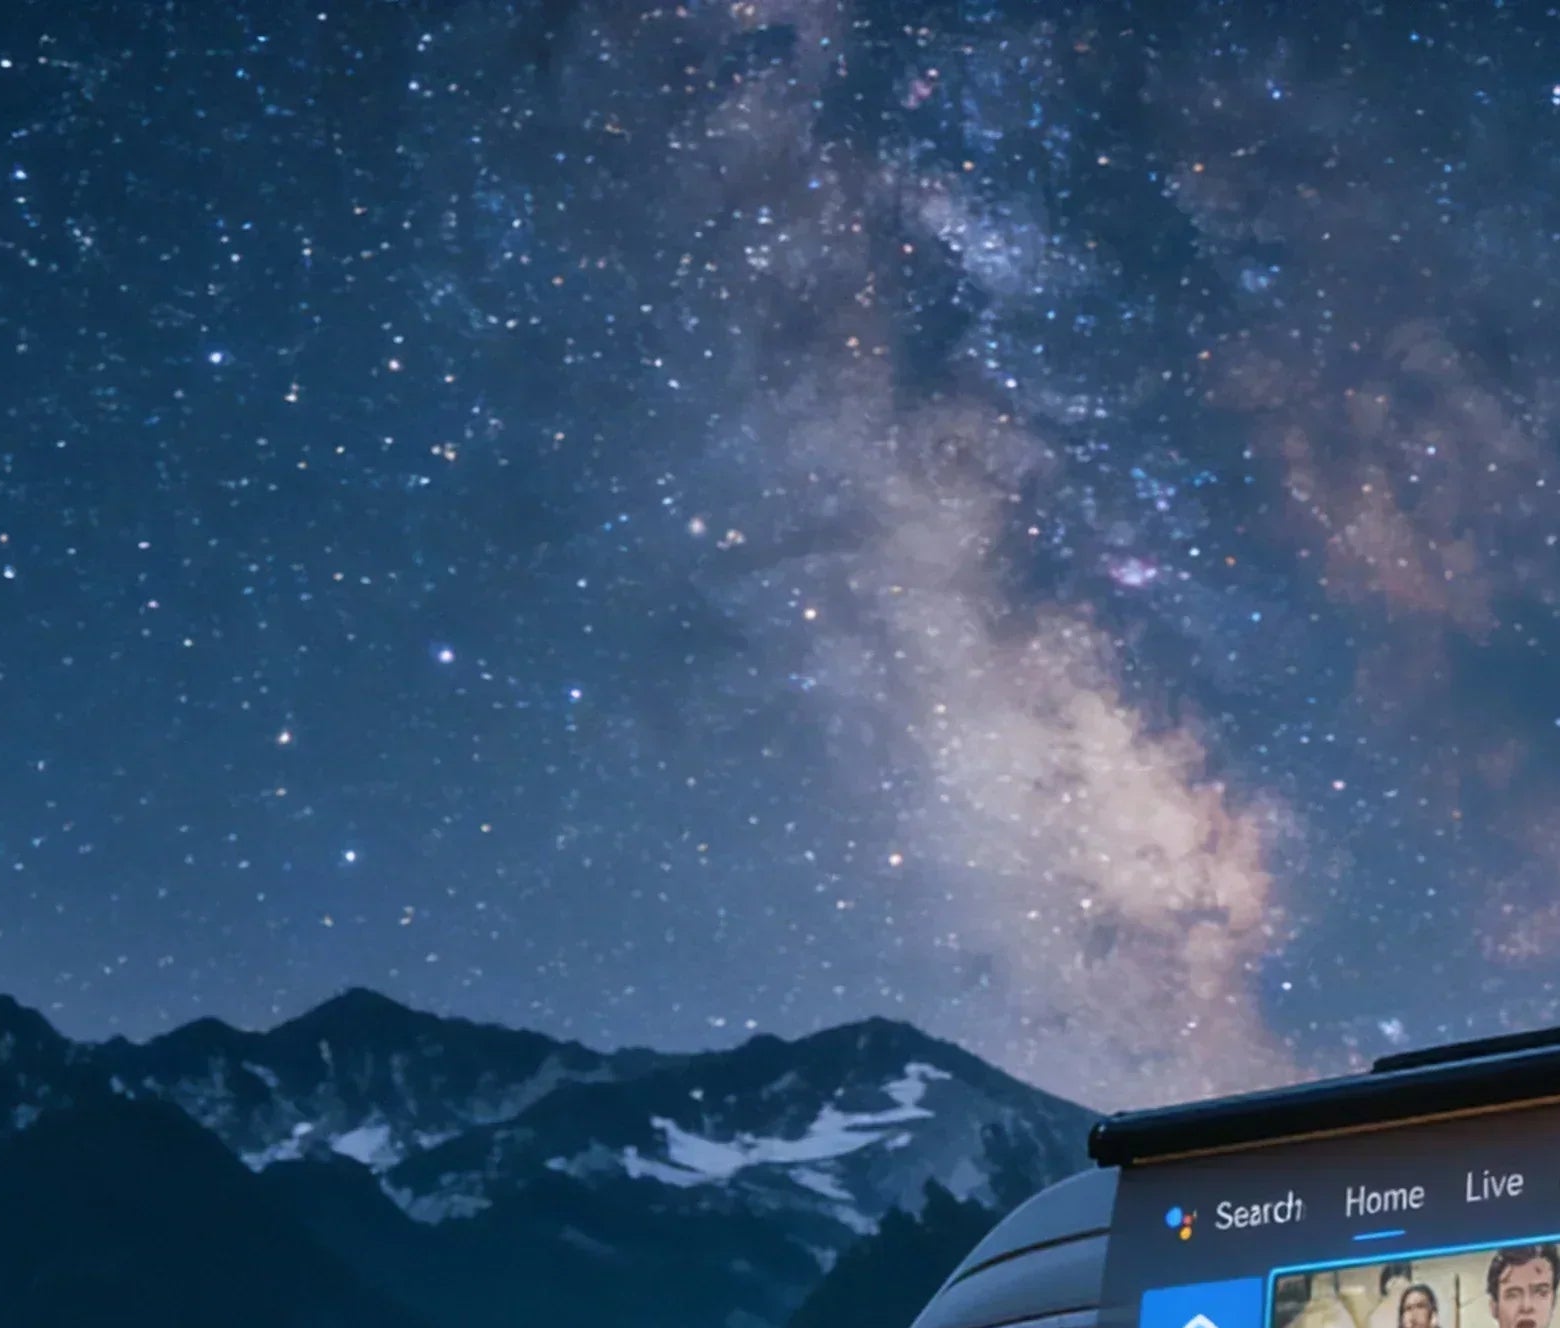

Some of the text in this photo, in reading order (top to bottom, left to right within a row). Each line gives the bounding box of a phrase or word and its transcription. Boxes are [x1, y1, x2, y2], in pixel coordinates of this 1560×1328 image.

[1345, 1183, 1425, 1217] Home
[1466, 1168, 1524, 1202] Live
[1214, 1190, 1304, 1230] Search
